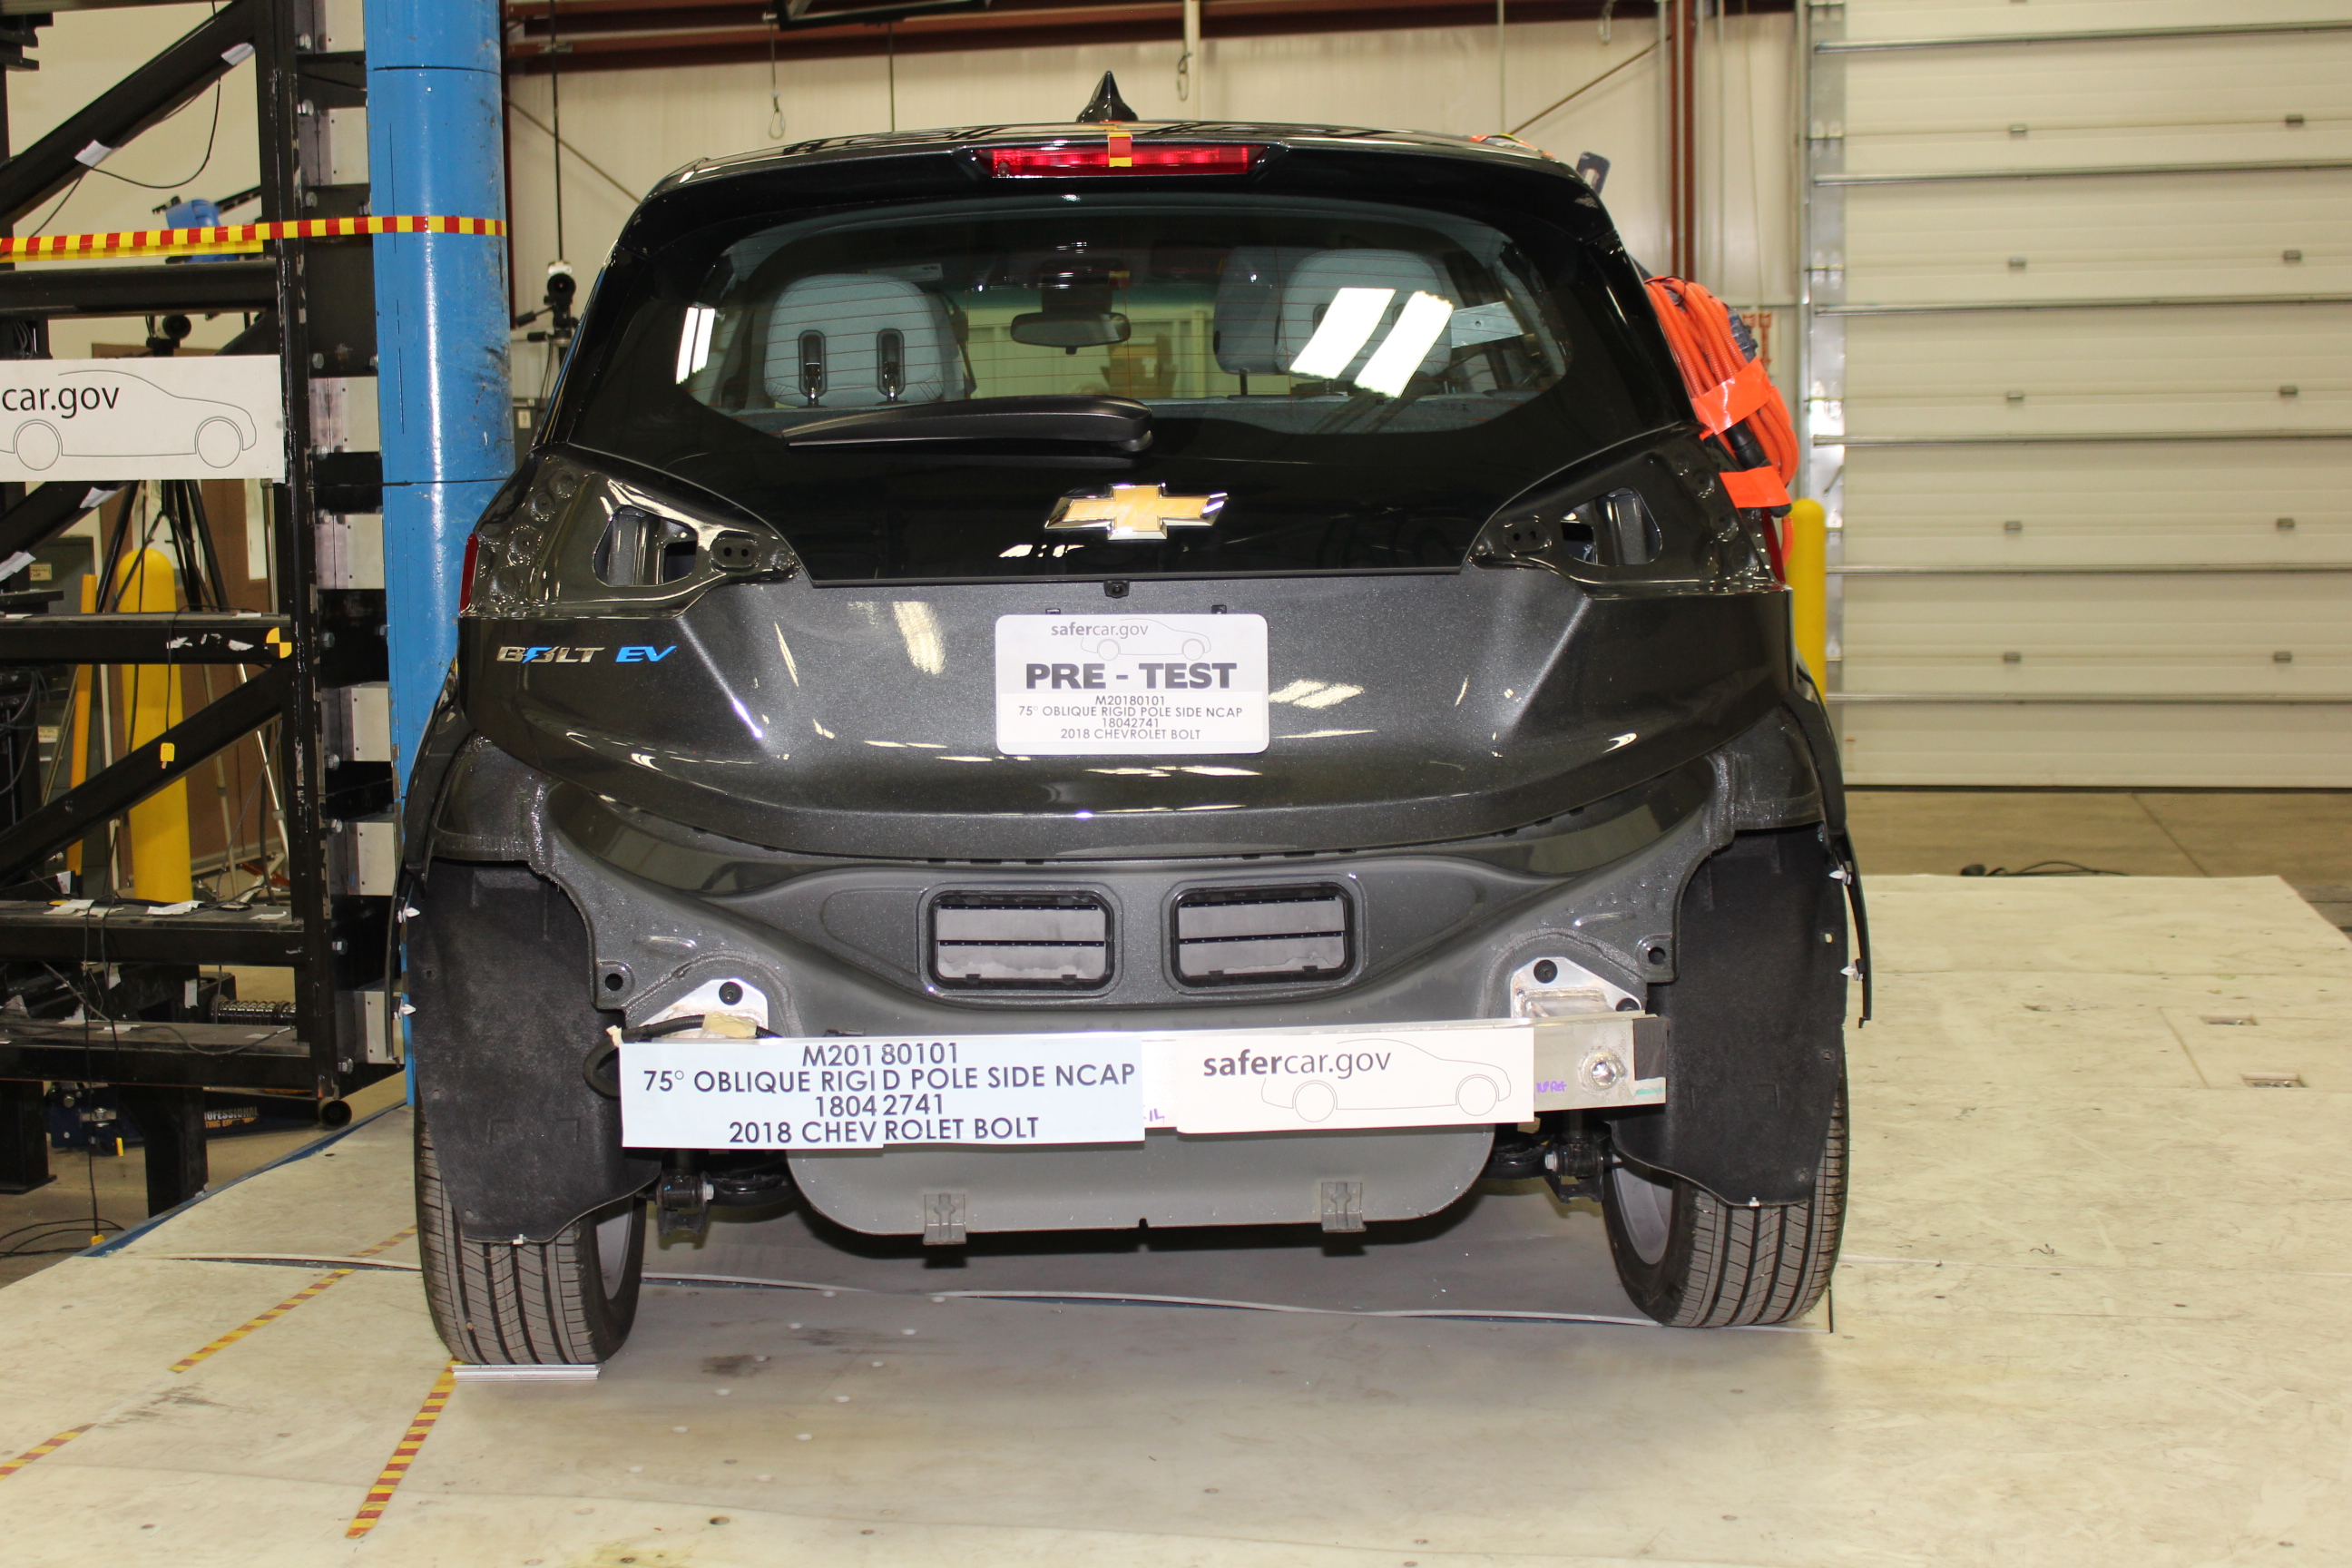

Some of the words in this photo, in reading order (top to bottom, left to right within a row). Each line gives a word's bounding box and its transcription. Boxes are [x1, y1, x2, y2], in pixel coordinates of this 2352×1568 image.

[1051, 622, 1149, 639] safercar.gov
[496, 645, 604, 663] BOLT
[615, 645, 677, 662] EV
[1025, 663, 1106, 690] PRE
[1138, 662, 1238, 690] TEST
[1094, 695, 1165, 706] M20180101
[1042, 705, 1097, 717] OBLIQUE
[1101, 706, 1136, 717] RIGID
[1141, 706, 1171, 717] POLE
[1175, 706, 1202, 718] SIDE
[1206, 707, 1243, 718] NCAP
[1061, 728, 1091, 740] 2018
[1093, 728, 1167, 740] CHEVROLET
[1171, 729, 1201, 740] BOLT
[1102, 718, 1159, 729] 18042741
[802, 1042, 957, 1067] M20180101
[1203, 1048, 1391, 1079] safercar.gov
[693, 1070, 810, 1094] OBLIQUE
[911, 1067, 978, 1090] POLE
[987, 1065, 1045, 1089] SIDE
[1055, 1063, 1135, 1087] NCAP
[815, 1093, 942, 1118] 18042741
[729, 1122, 792, 1143] 2018
[801, 1119, 963, 1143] CHEVROLET
[975, 1116, 1039, 1140] BOLT
